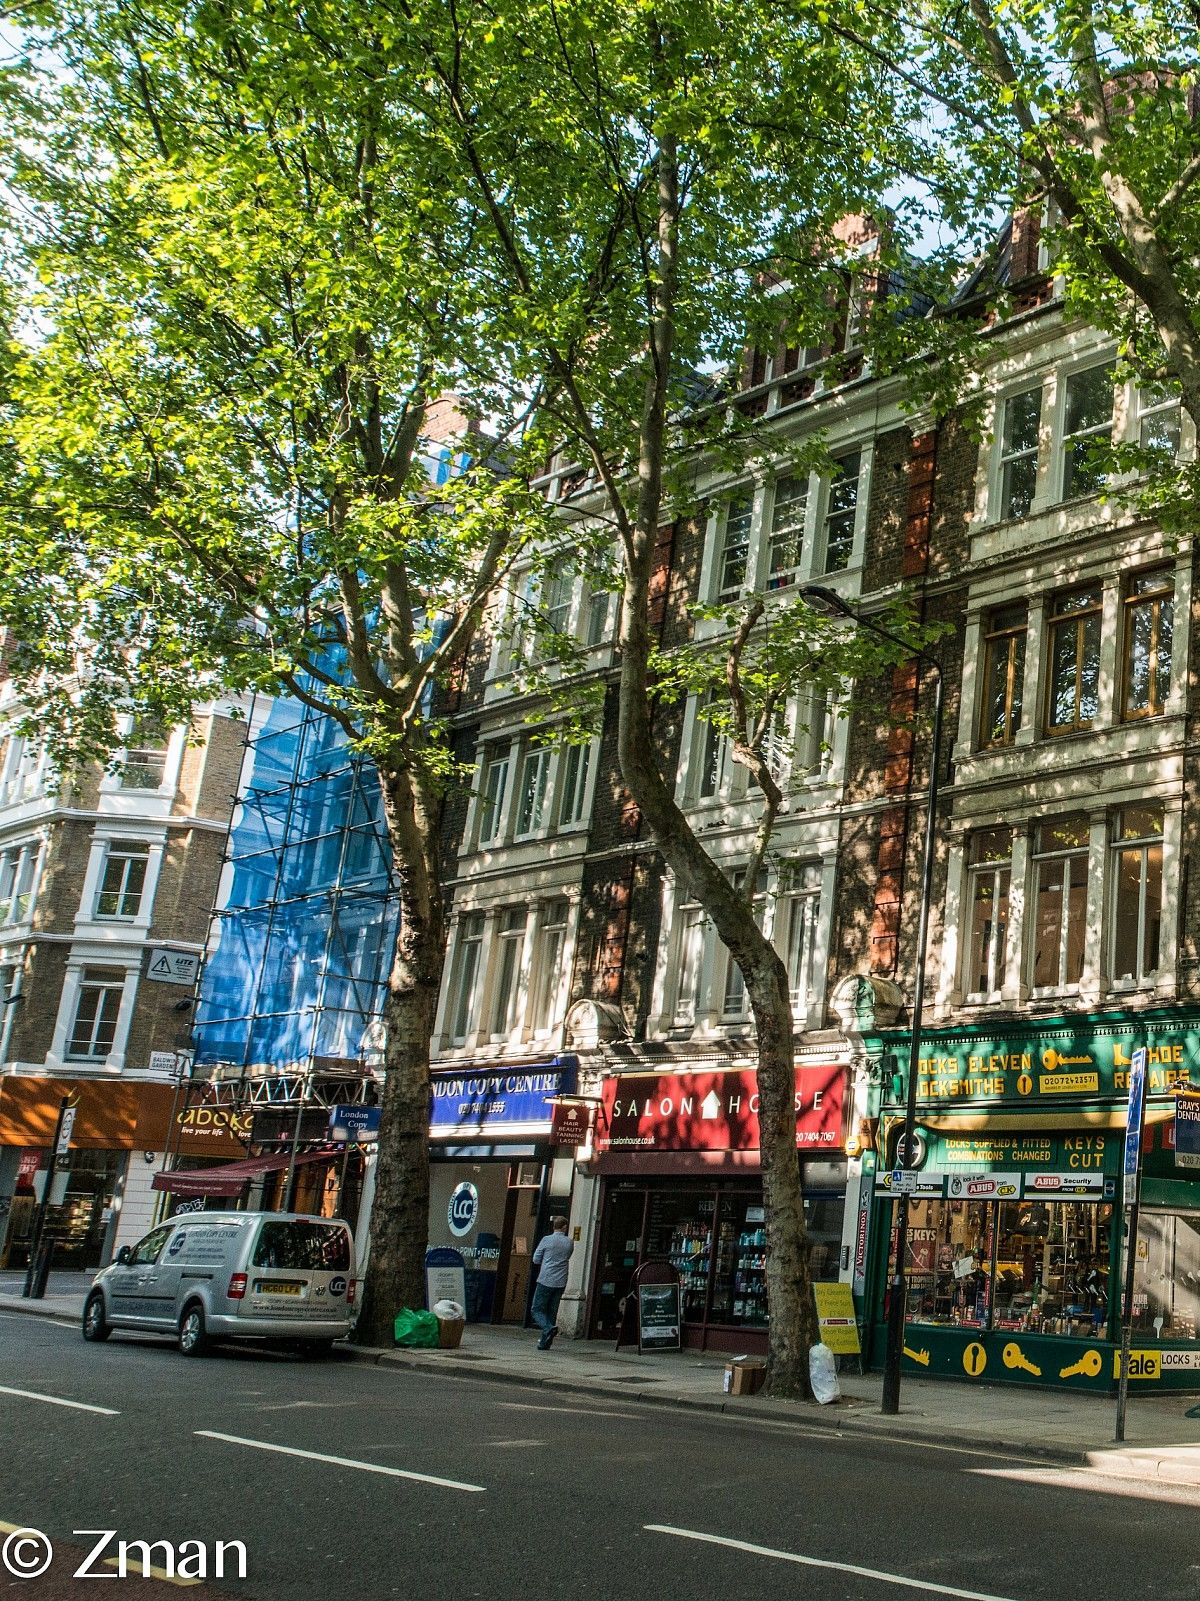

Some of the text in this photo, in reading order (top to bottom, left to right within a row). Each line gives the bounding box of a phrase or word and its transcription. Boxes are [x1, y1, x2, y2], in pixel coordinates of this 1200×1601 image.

[175, 957, 194, 966] LITE
[1147, 1045, 1184, 1064] HOE
[918, 1053, 1032, 1075] OCKS ELEVEN
[1044, 1075, 1095, 1086] 02072423571
[1114, 1069, 1190, 1088] REAIRS
[430, 1073, 562, 1098] NDON COPY CENTRE
[613, 1091, 823, 1118] SALON HOSE
[1177, 1100, 1200, 1112] GRAY'S
[340, 1110, 369, 1119] London
[1177, 1109, 1200, 1122] DENTAL
[347, 1120, 368, 1130] Copy
[181, 1126, 194, 1134] live
[194, 1128, 211, 1136] your
[211, 1128, 224, 1137] life
[804, 1132, 820, 1142] 7404
[820, 1131, 836, 1142] 7067
[945, 1139, 971, 1149] LOCKS
[974, 1139, 1011, 1149] SUPPLIED
[1022, 1138, 1051, 1149] FITTED
[1064, 1136, 1105, 1150] KEYS
[947, 1150, 1051, 1161] COMBINATIONS CHANGED
[1069, 1153, 1104, 1168] CUT
[1036, 1178, 1092, 1186] ABUS Security
[969, 1183, 993, 1194] ABUS
[453, 1200, 473, 1219] LCC
[856, 1210, 868, 1267] VICTORINOX
[914, 1230, 937, 1241] KEYS
[460, 1247, 477, 1257] PRINT
[1161, 1354, 1190, 1365] LOCKS
